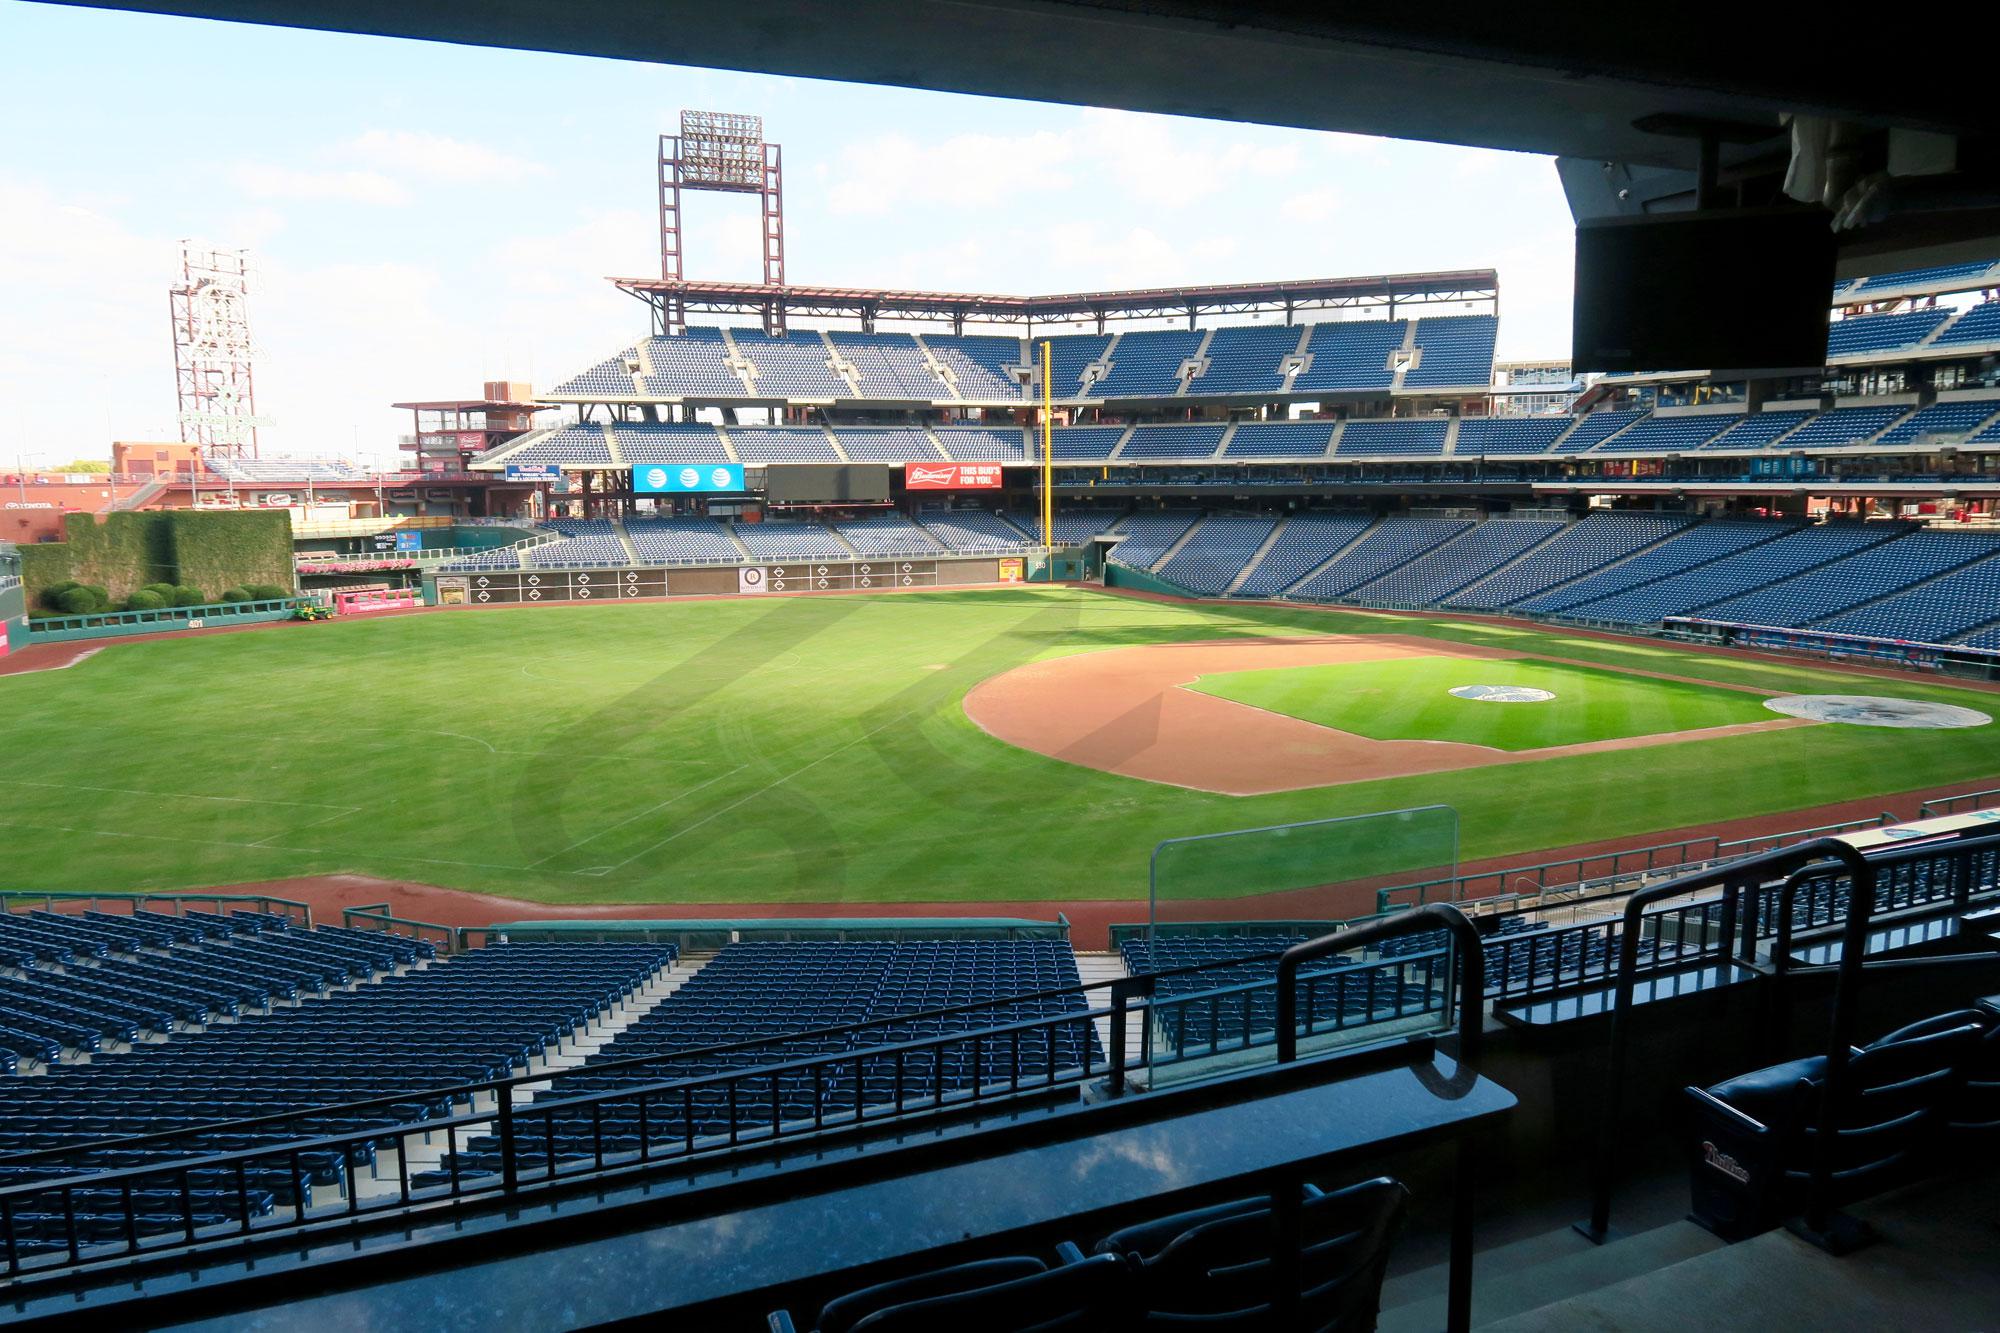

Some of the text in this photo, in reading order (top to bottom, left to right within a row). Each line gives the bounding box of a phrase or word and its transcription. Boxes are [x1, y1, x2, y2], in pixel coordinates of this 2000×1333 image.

[960, 466, 1000, 475] THIS BUD'S
[960, 476, 992, 485] FOR YOU.
